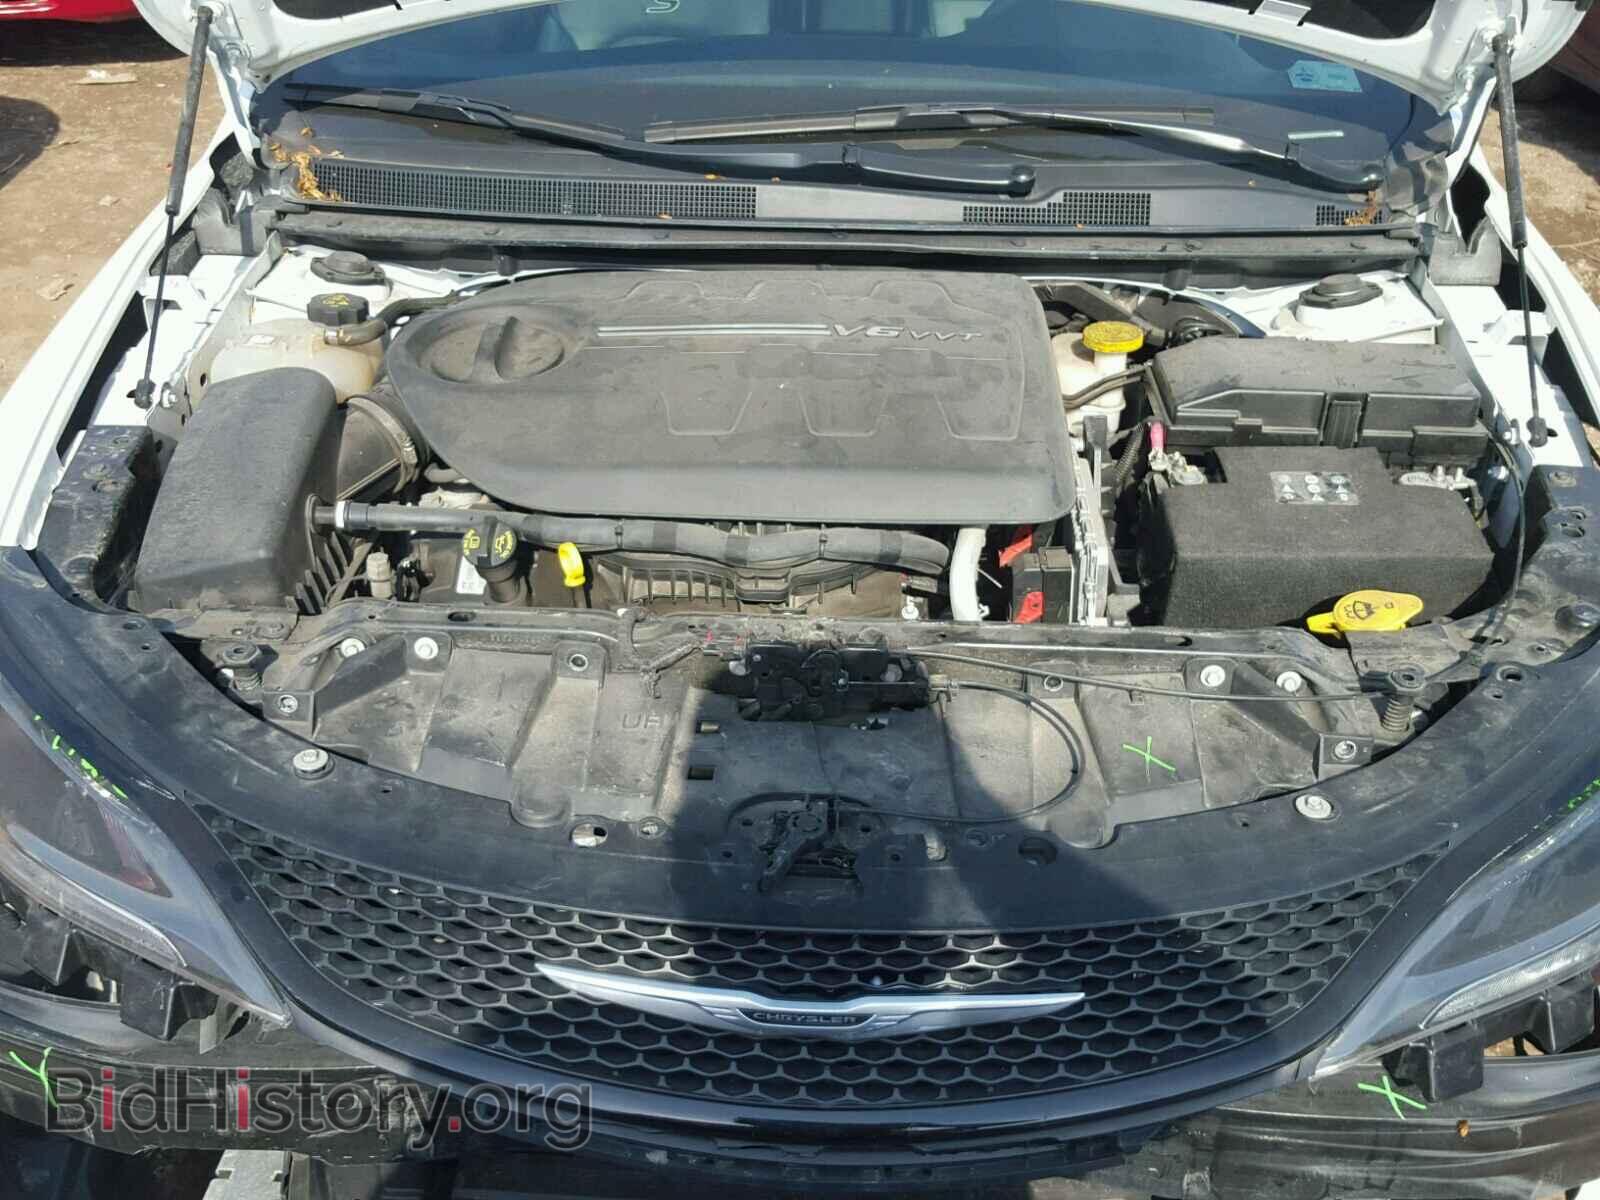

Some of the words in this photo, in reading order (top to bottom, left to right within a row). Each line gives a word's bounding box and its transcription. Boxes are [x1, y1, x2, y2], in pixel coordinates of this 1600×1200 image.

[832, 323, 905, 337] V6
[909, 328, 983, 342] VVT
[752, 1011, 857, 1024] CHRYSLER
